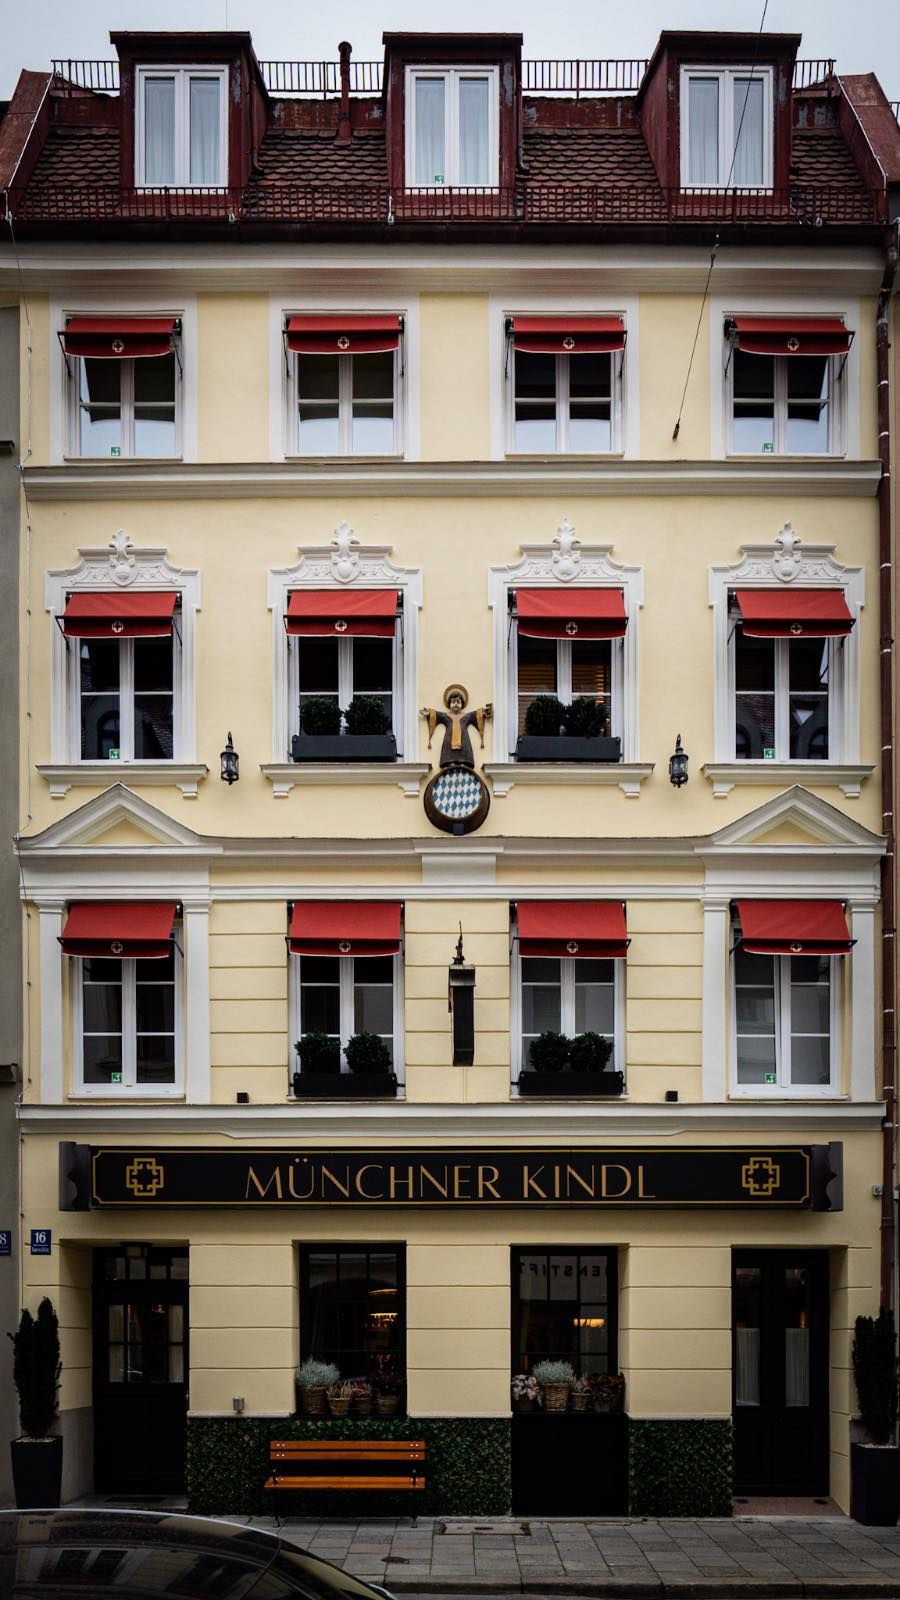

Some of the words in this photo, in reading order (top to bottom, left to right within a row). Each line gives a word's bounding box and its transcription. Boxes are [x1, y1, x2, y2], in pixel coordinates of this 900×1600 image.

[245, 1157, 501, 1199] MÜNCHNER
[522, 1164, 657, 1199] KINDL
[35, 1231, 46, 1244] 16
